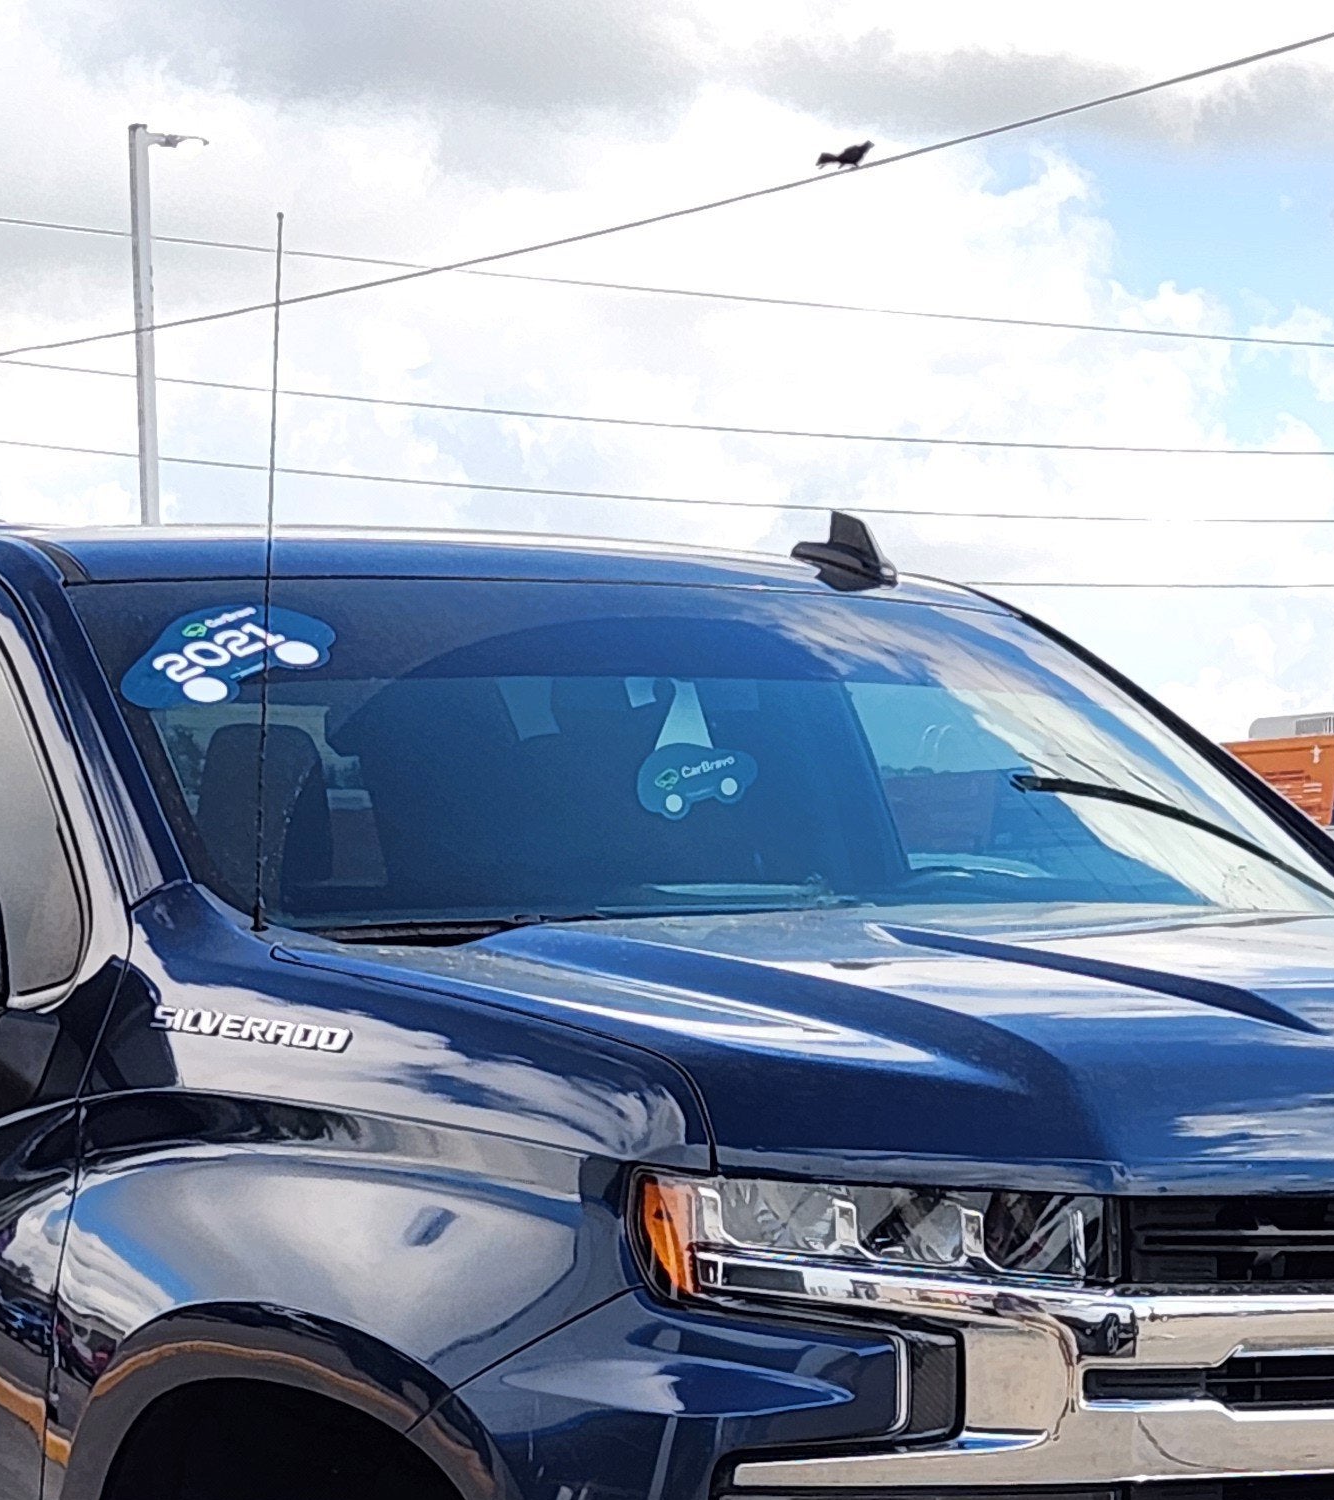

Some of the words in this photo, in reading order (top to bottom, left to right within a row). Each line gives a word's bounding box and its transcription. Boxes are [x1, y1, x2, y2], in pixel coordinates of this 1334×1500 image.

[152, 622, 286, 683] 2021
[681, 756, 735, 778] CarBravo
[150, 1004, 352, 1053] SILVERADO
